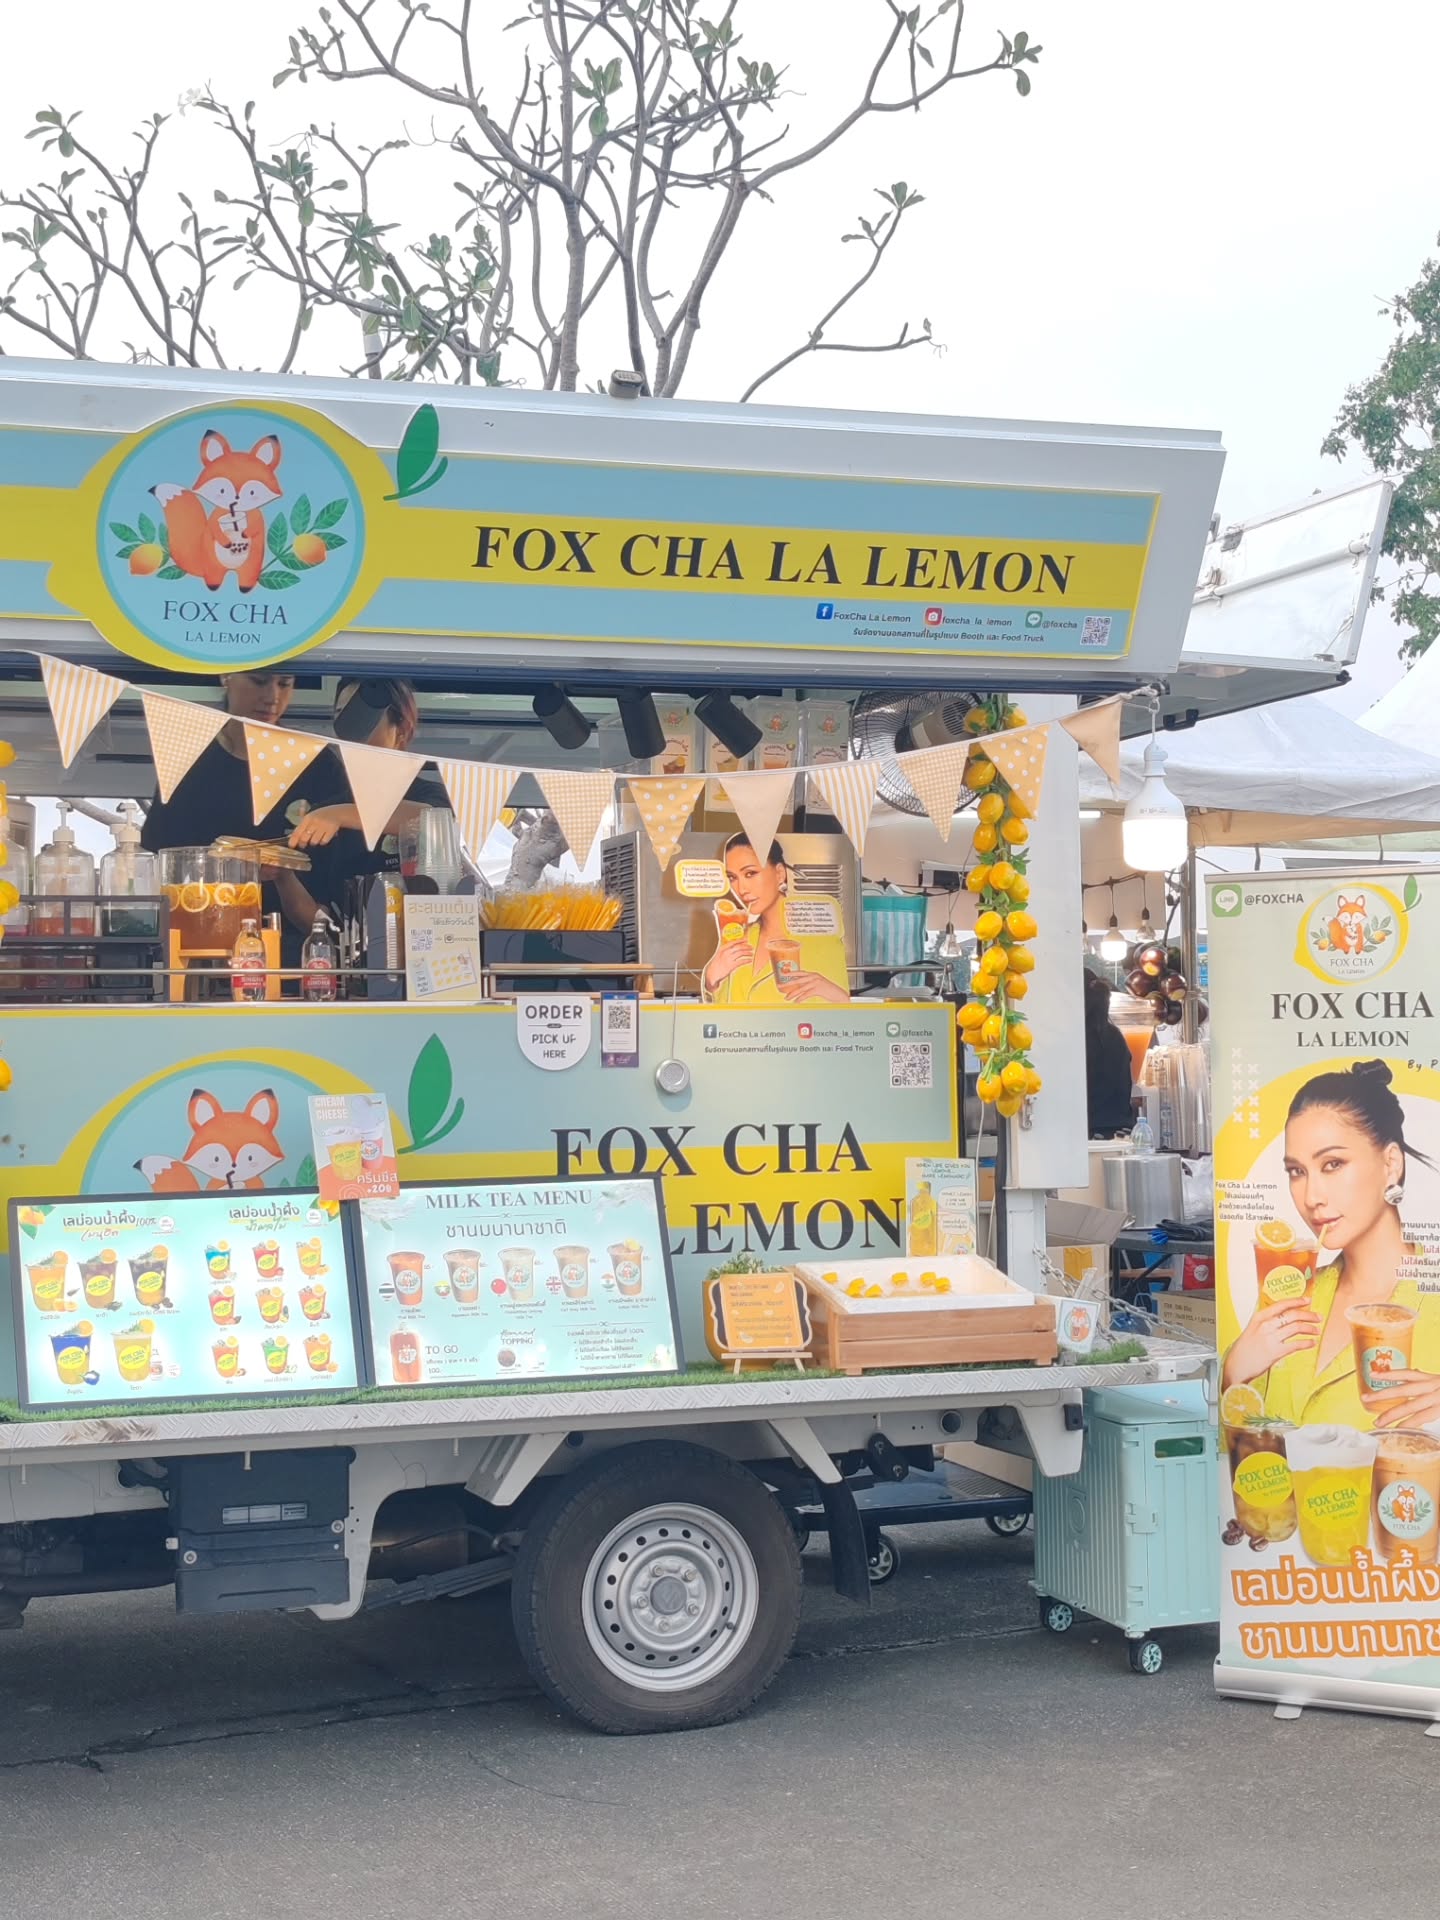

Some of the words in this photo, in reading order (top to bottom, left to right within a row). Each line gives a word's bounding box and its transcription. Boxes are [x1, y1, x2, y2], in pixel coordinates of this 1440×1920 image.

[471, 526, 600, 573] FOX
[619, 533, 745, 580] CHA
[765, 541, 842, 584] LA
[862, 545, 1074, 595] LEMON
[163, 600, 219, 622] FOX
[229, 603, 288, 625] CHA
[834, 612, 867, 621] FoxCha
[869, 613, 880, 622] La
[881, 614, 911, 623] Lemon
[185, 631, 204, 642] LA
[210, 632, 261, 644] LEMON
[961, 631, 984, 641] Booth
[1001, 634, 1021, 642] Food
[1023, 634, 1045, 642] Truck
[1244, 893, 1304, 906] @FOXCHA
[1330, 959, 1350, 967] FOX
[1352, 958, 1374, 967] CHA
[525, 1005, 583, 1019] ORDER
[1270, 992, 1344, 1020] FOX
[1355, 991, 1434, 1019] CHA
[532, 1034, 558, 1044] PICK
[719, 1031, 747, 1039] FoxCha
[749, 1031, 759, 1039] La
[760, 1031, 786, 1039] Lemon
[902, 1029, 933, 1037] @foxcha
[1296, 1032, 1325, 1047] LA
[1331, 1030, 1410, 1047] LEMON
[543, 1050, 566, 1058] HERE
[1407, 1059, 1422, 1072] By
[316, 1108, 349, 1120] CHEESE
[551, 1126, 697, 1177] FOX
[723, 1122, 873, 1176] CHA
[357, 1170, 398, 1185] ครีมชีส
[425, 1193, 481, 1209] MILK
[487, 1191, 527, 1208] TEA
[533, 1189, 593, 1206] MENU
[446, 1218, 568, 1239] ชานมนานาชาติ
[1266, 1277, 1284, 1288] FOX
[1284, 1272, 1302, 1283] CHA
[425, 1345, 440, 1355] TO
[443, 1344, 459, 1354] GO
[1238, 1470, 1263, 1485] FOX
[1263, 1463, 1289, 1479] CHA
[1245, 1484, 1257, 1493] LA
[1257, 1475, 1288, 1490] LEMON
[1307, 1494, 1330, 1509] FOX
[1332, 1487, 1360, 1501] CHA
[1313, 1507, 1327, 1517] LA
[1327, 1499, 1356, 1513] LEMON
[1235, 1549, 1440, 1603] เลม่อนน้ำผึ้ง
